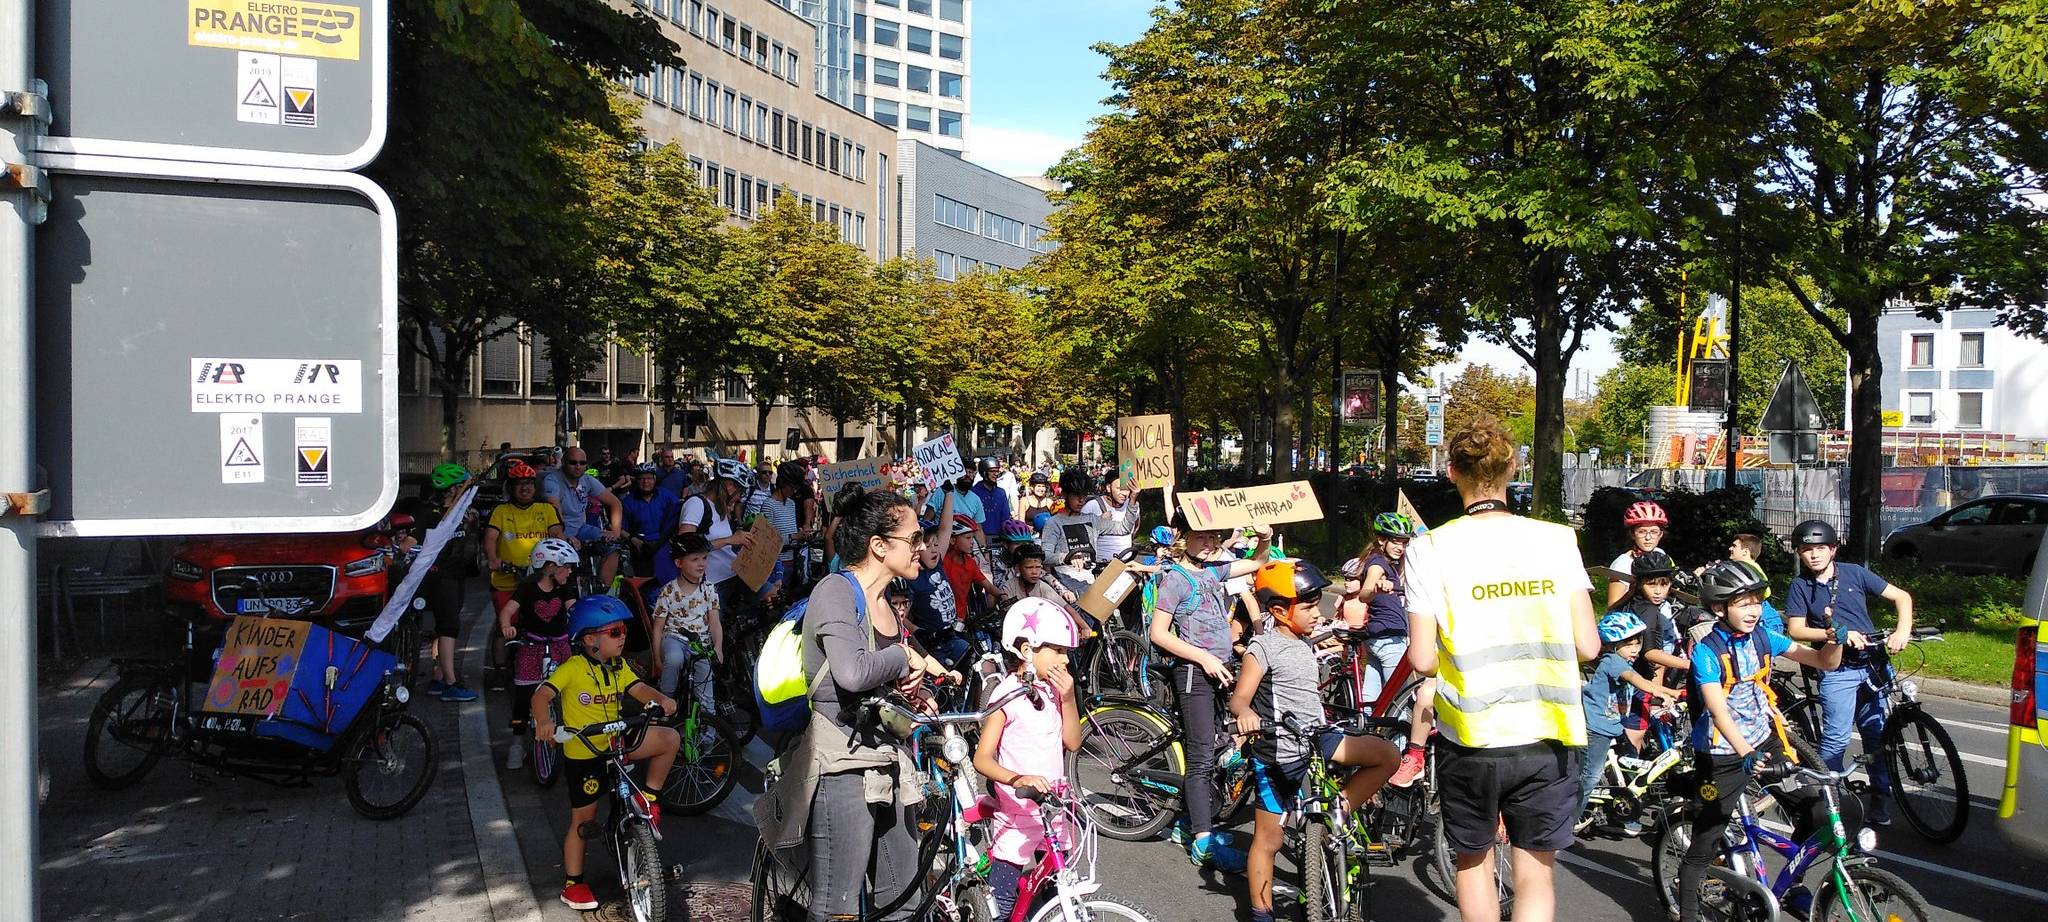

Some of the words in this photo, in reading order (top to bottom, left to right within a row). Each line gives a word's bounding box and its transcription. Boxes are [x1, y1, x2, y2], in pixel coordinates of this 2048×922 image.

[248, 2, 298, 16] ELEKTRO
[195, 8, 298, 37] PRANGE
[249, 67, 272, 76] 2019
[196, 393, 266, 404] ELEKTRO
[273, 394, 342, 404] PRANGE
[230, 427, 253, 435] 2017
[1120, 423, 1170, 451] KIDICAL
[914, 440, 953, 466] KIDICAL
[822, 463, 876, 481] Sicherheit
[931, 457, 964, 482] MASS
[1136, 455, 1170, 481] MASS
[1246, 499, 1294, 519] FAHRRAD
[1468, 502, 1496, 514] Canon
[1472, 579, 1556, 601] ORDNER
[231, 655, 278, 681] AUFS
[238, 687, 274, 713] RAD
[1788, 846, 1807, 875] BBF
